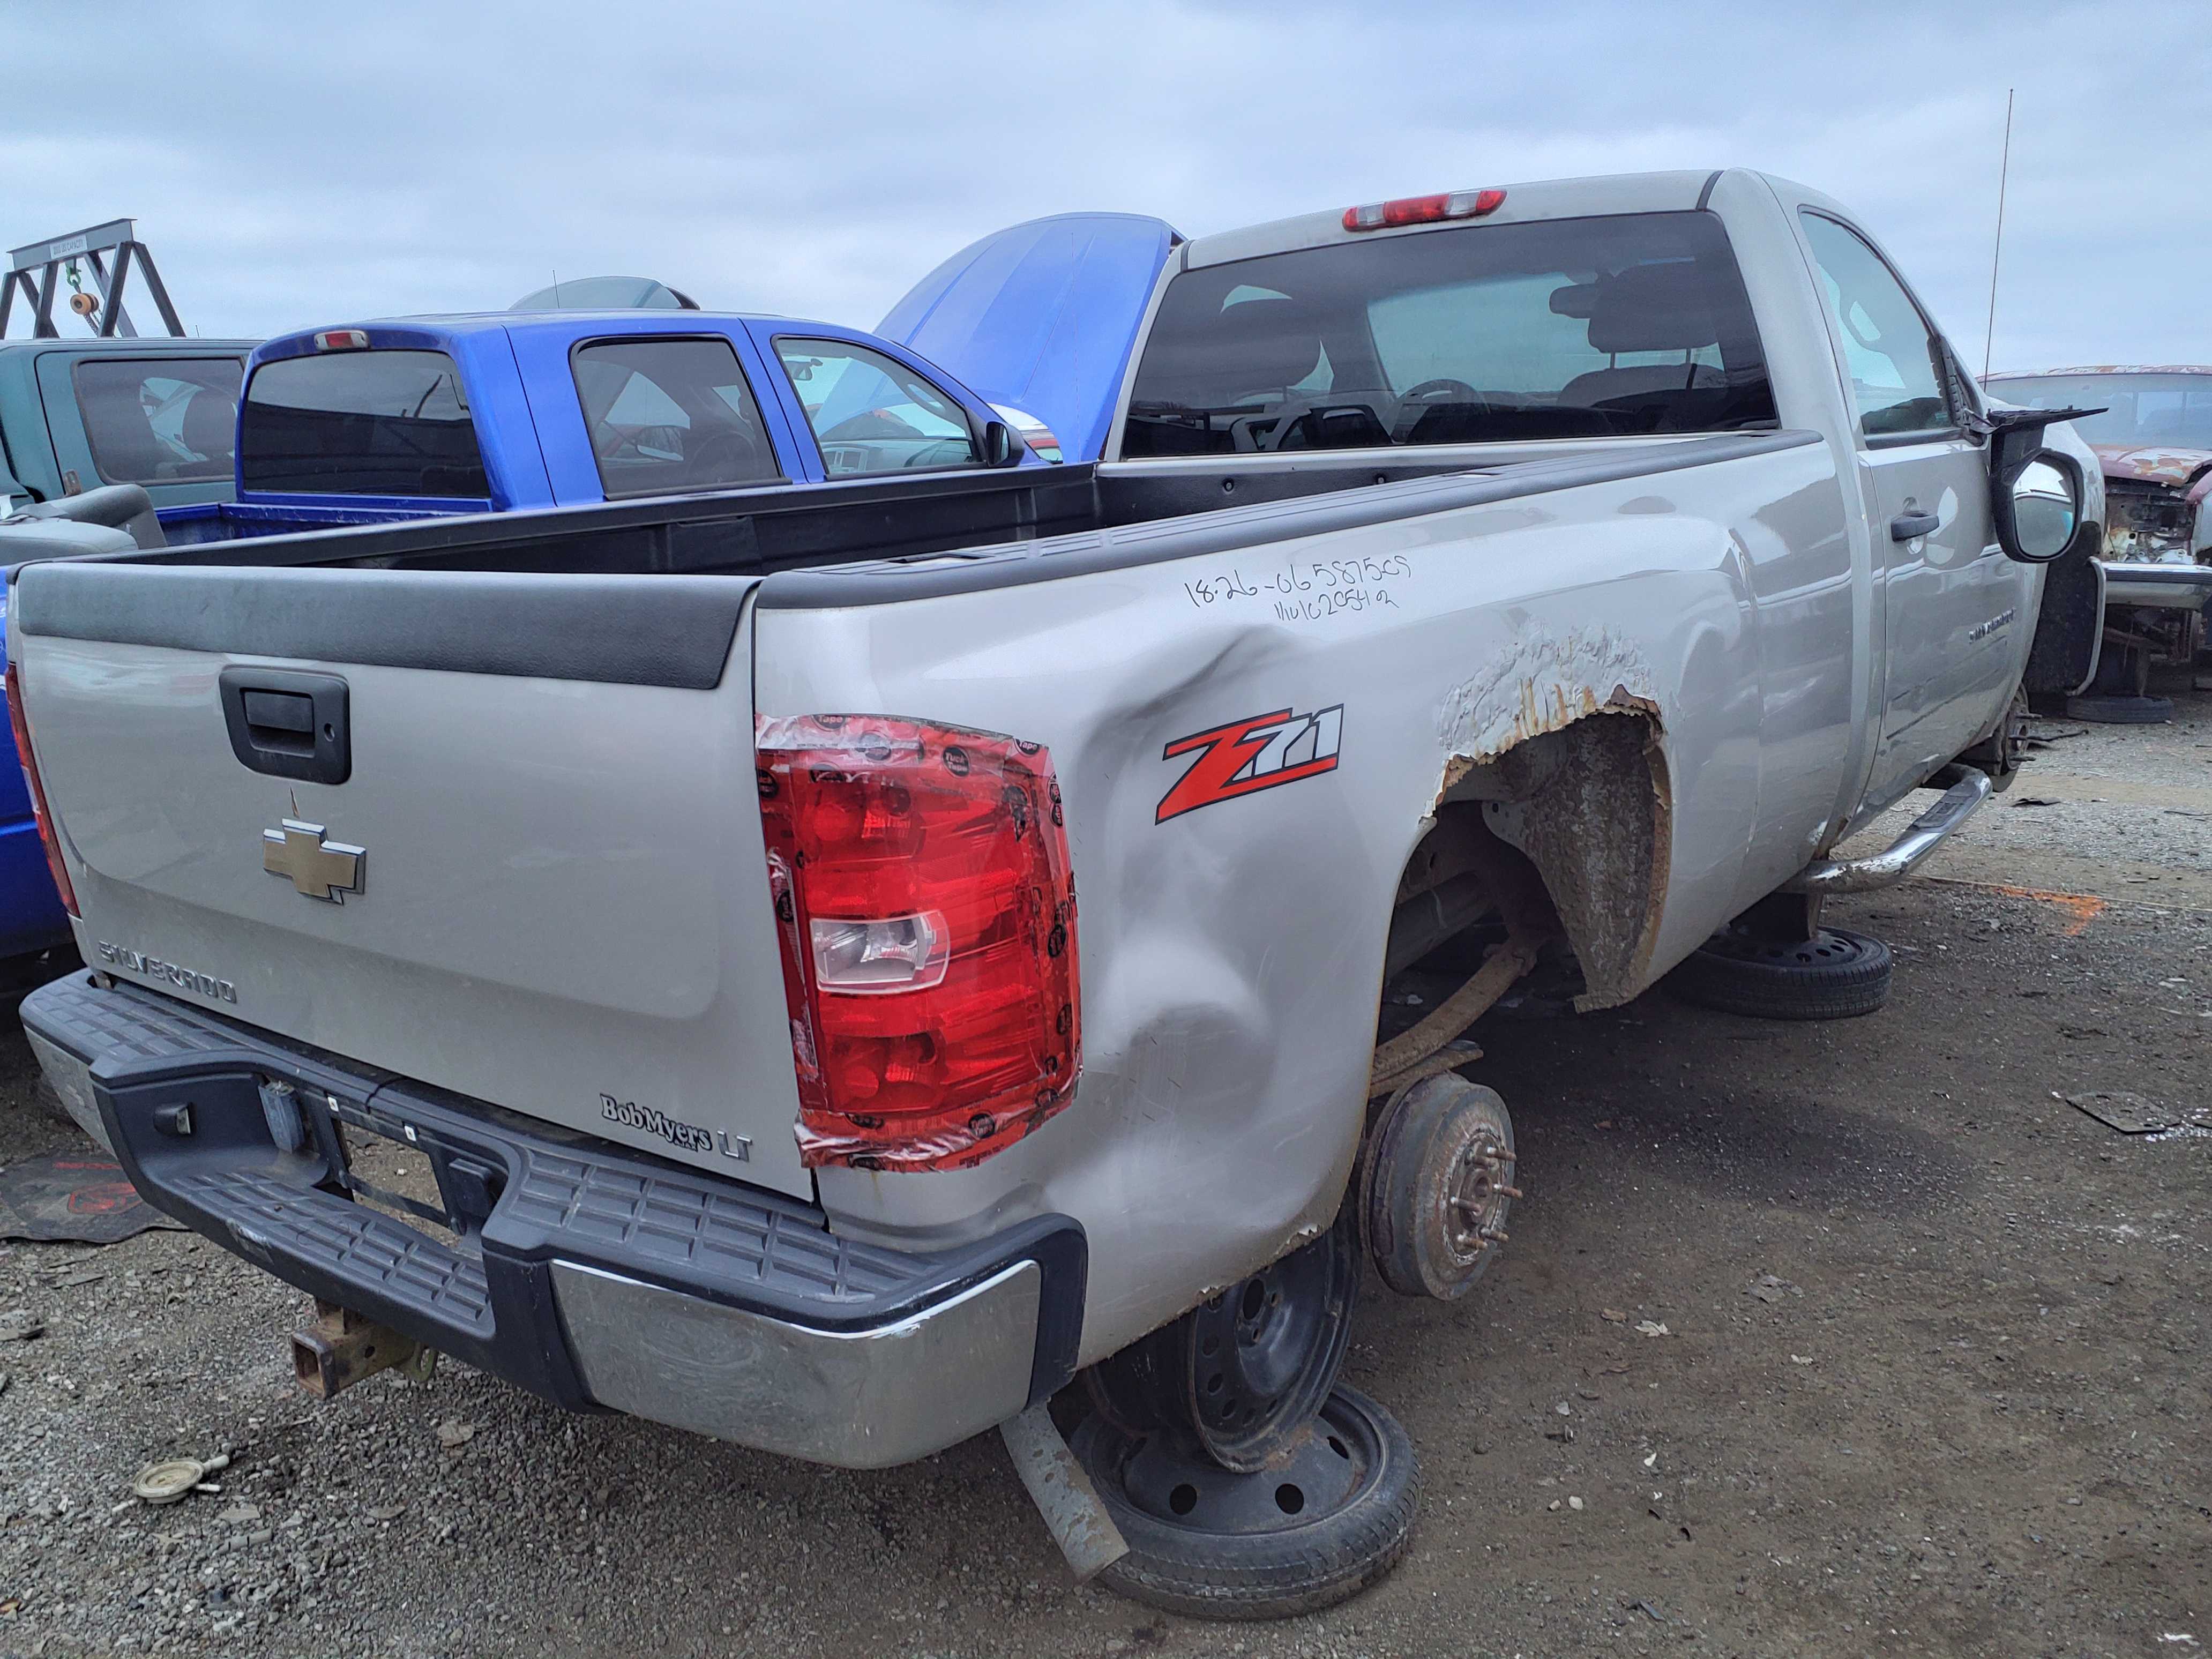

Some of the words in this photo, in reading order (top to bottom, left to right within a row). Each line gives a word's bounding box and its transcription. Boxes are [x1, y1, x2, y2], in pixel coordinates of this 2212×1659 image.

[945, 752, 965, 764] Tuck
[1154, 703, 1344, 826] Z71
[99, 939, 237, 1004] SILVERADO
[717, 1130, 753, 1163] LT
